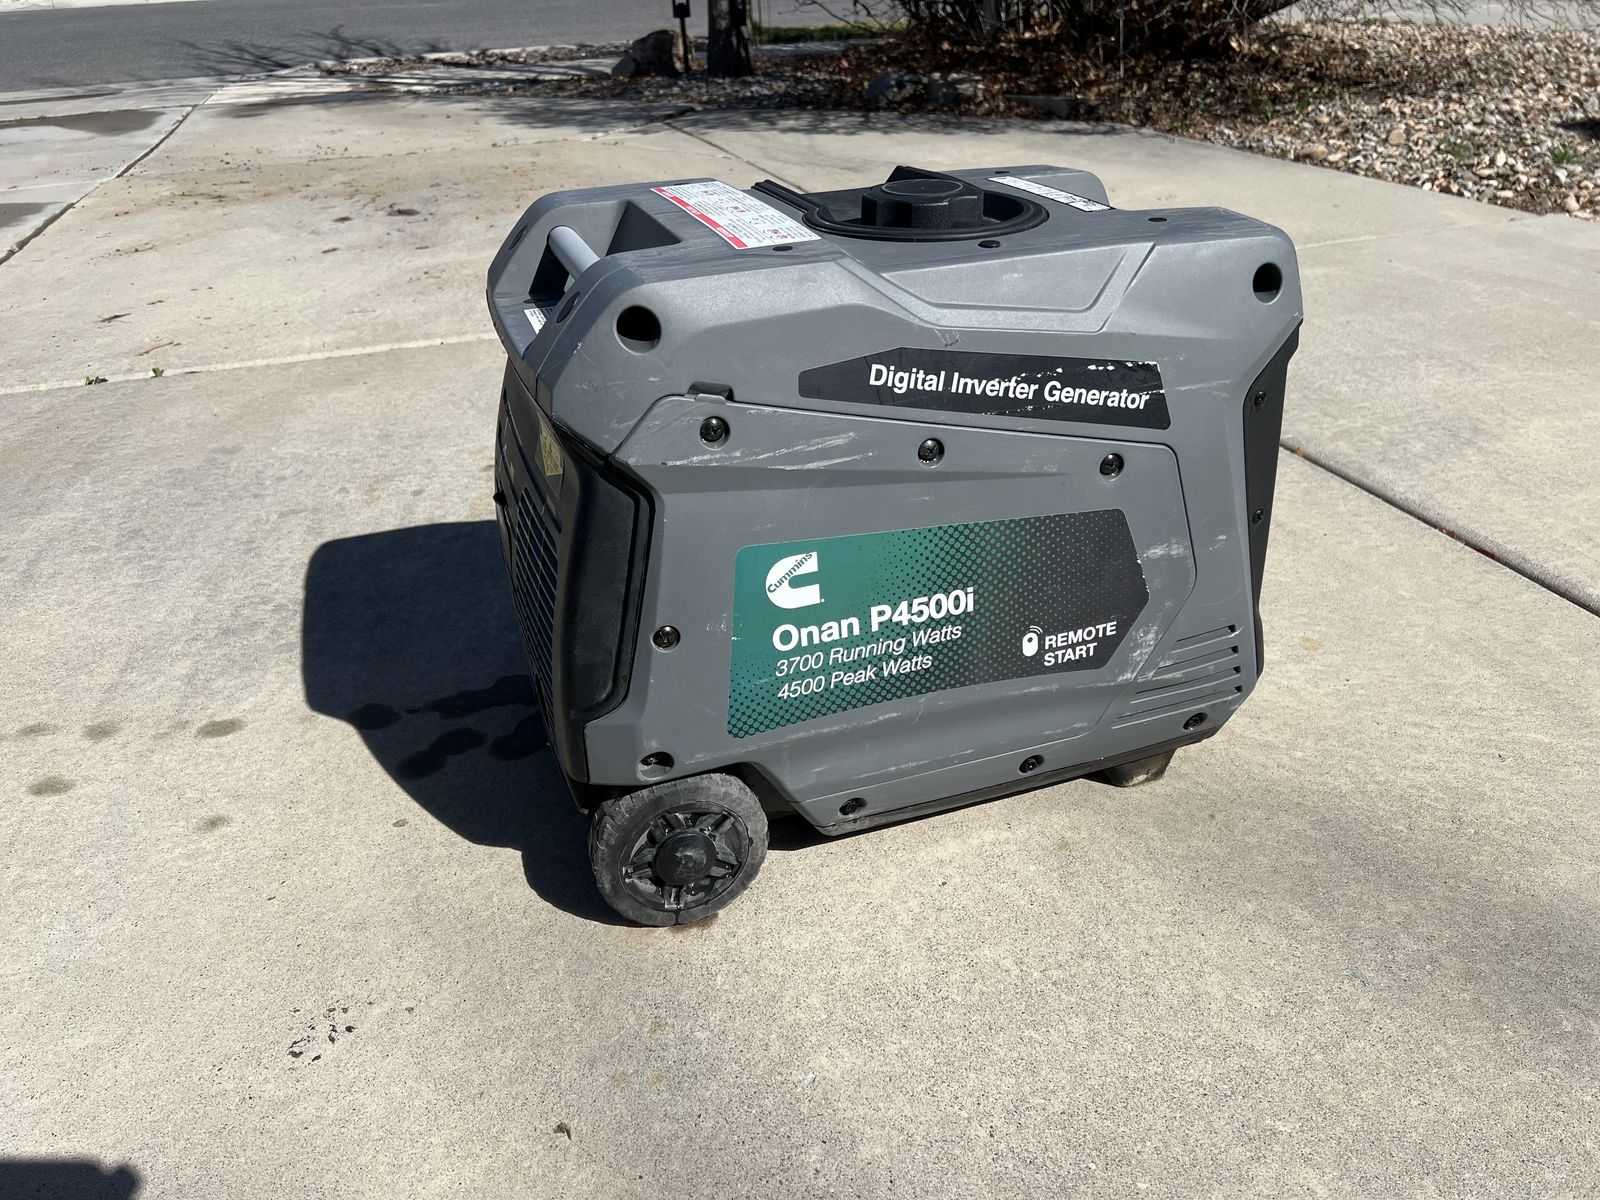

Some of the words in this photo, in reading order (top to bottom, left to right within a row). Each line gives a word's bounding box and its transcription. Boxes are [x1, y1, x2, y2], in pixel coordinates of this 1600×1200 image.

[869, 364, 945, 393] Digital
[951, 372, 1038, 401] Inverter
[1044, 381, 1149, 410] Generator
[767, 551, 813, 594] Cummins
[772, 616, 859, 652] Onan
[870, 587, 975, 631] P4500i
[1044, 621, 1117, 649] REMOTE
[775, 653, 823, 677] 3700
[829, 634, 906, 664] Running
[912, 624, 962, 646] Watts
[1043, 642, 1098, 666] START
[777, 676, 825, 700] 4500
[830, 665, 876, 687] Peak
[882, 654, 933, 677] Watts
